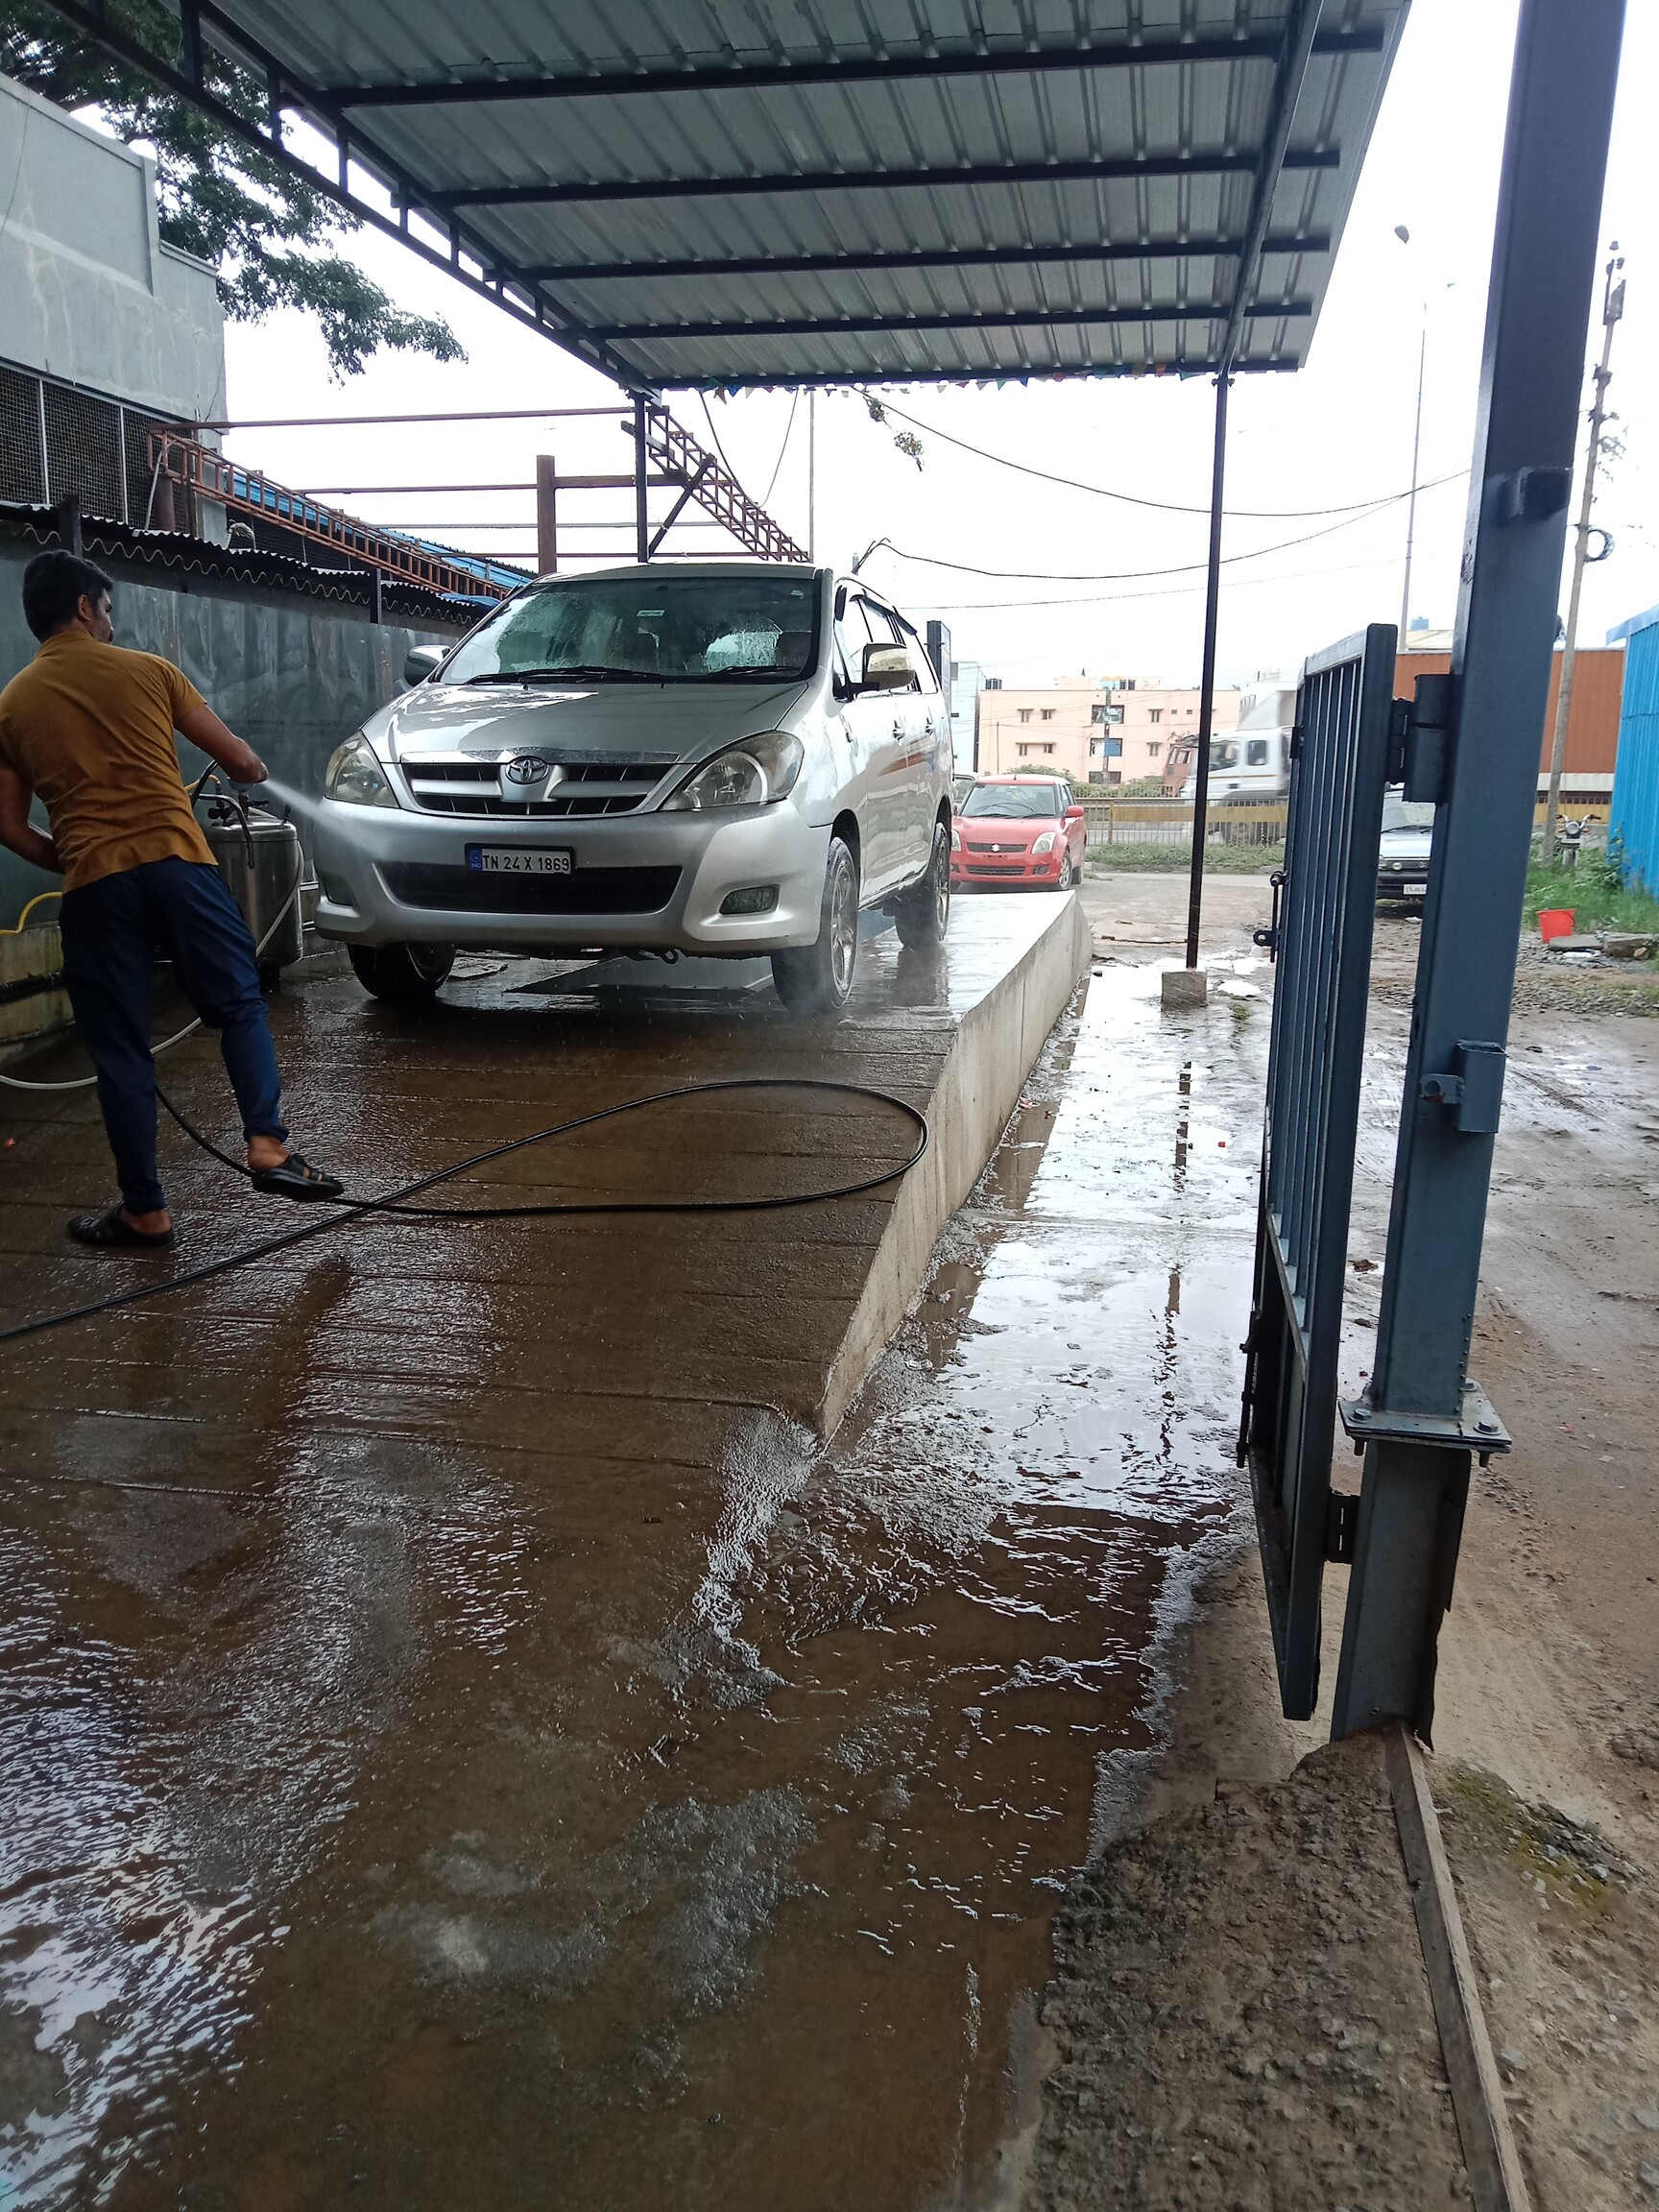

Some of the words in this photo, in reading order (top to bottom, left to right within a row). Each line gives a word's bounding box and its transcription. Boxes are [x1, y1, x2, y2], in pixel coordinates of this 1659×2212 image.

[483, 854, 498, 869] TN
[503, 856, 520, 870] 24
[524, 856, 533, 871] X
[538, 857, 569, 871] 1869
